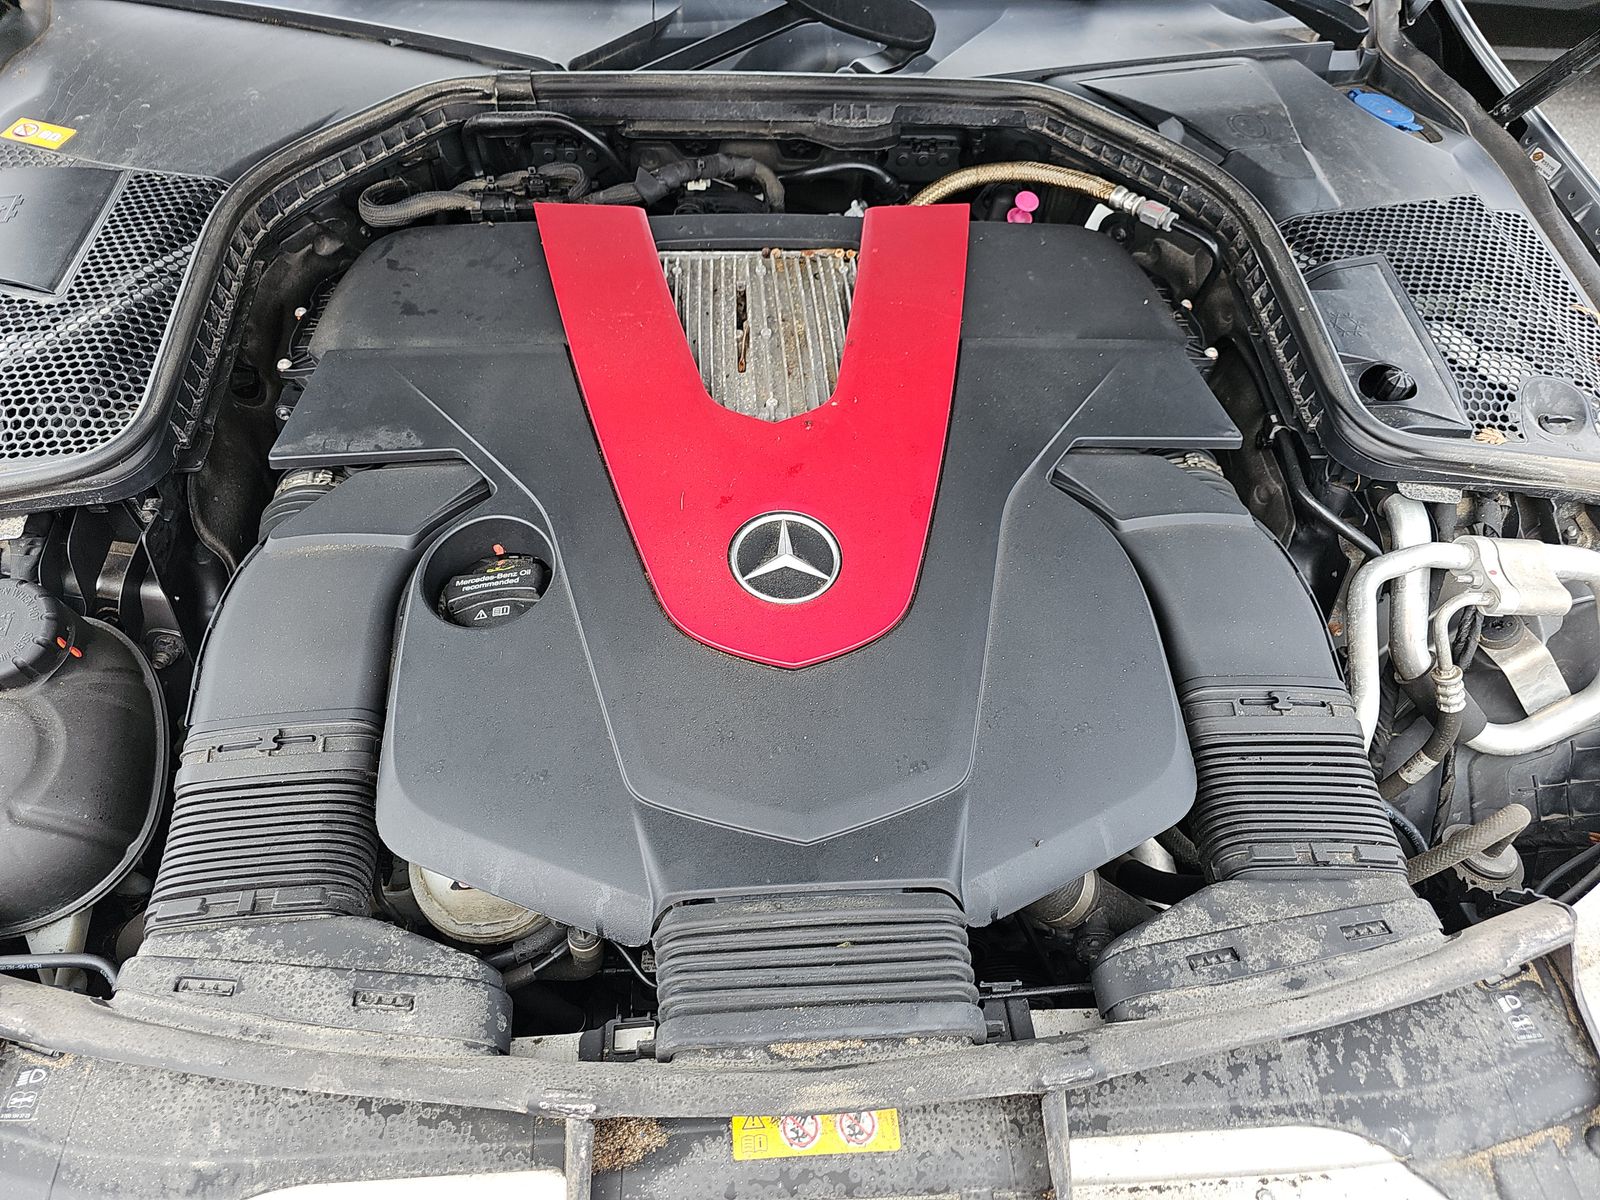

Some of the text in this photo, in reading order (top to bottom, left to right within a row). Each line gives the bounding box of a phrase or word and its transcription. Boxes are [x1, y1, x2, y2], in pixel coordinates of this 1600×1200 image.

[455, 572, 518, 586] Mercedes-Benz
[462, 577, 520, 592] recommended
[13, 589, 35, 609] WHEN
